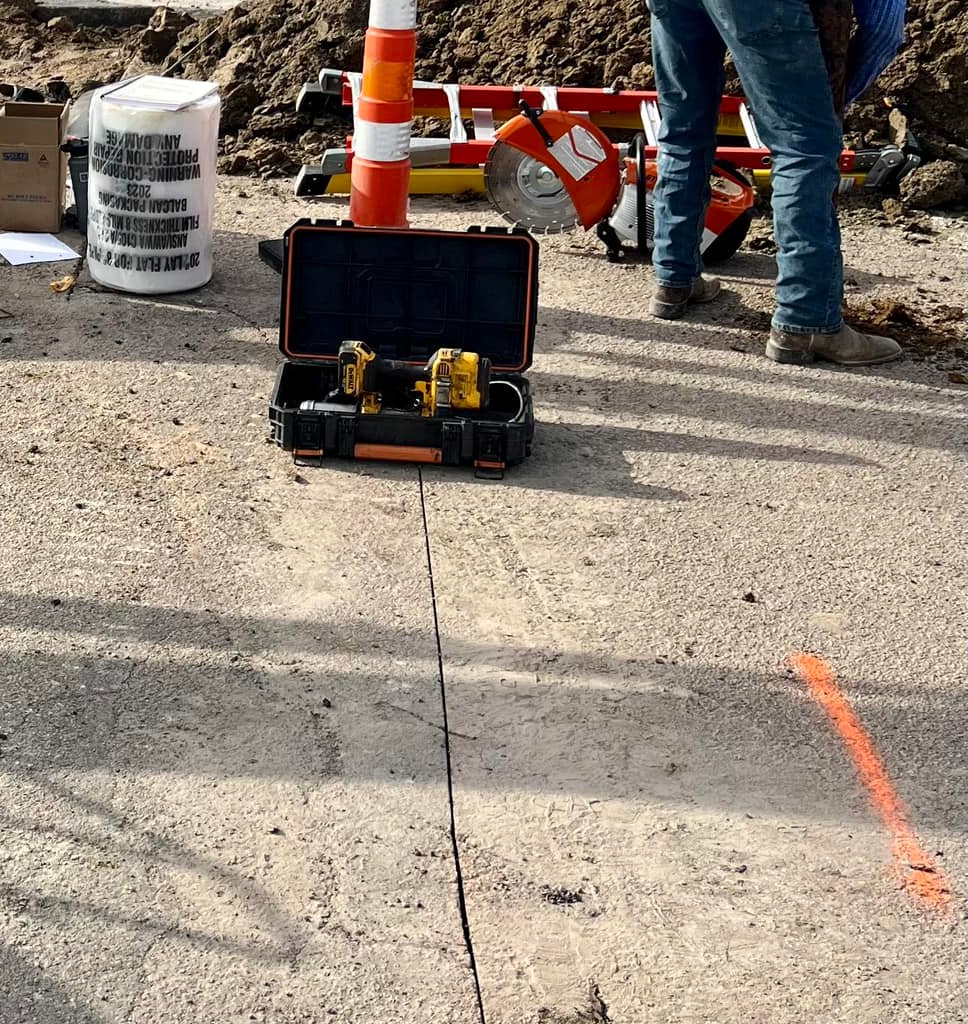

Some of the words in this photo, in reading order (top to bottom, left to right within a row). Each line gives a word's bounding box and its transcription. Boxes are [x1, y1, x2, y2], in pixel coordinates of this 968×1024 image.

[126, 148, 199, 167] PROTECTION
[127, 183, 151, 199] 2023
[98, 191, 146, 213] PACKAGING
[148, 198, 188, 214] BALCAN
[132, 216, 182, 234] THICKNESS
[181, 214, 200, 232] FILM
[135, 255, 162, 273] FLAT
[163, 254, 183, 273] LAY
